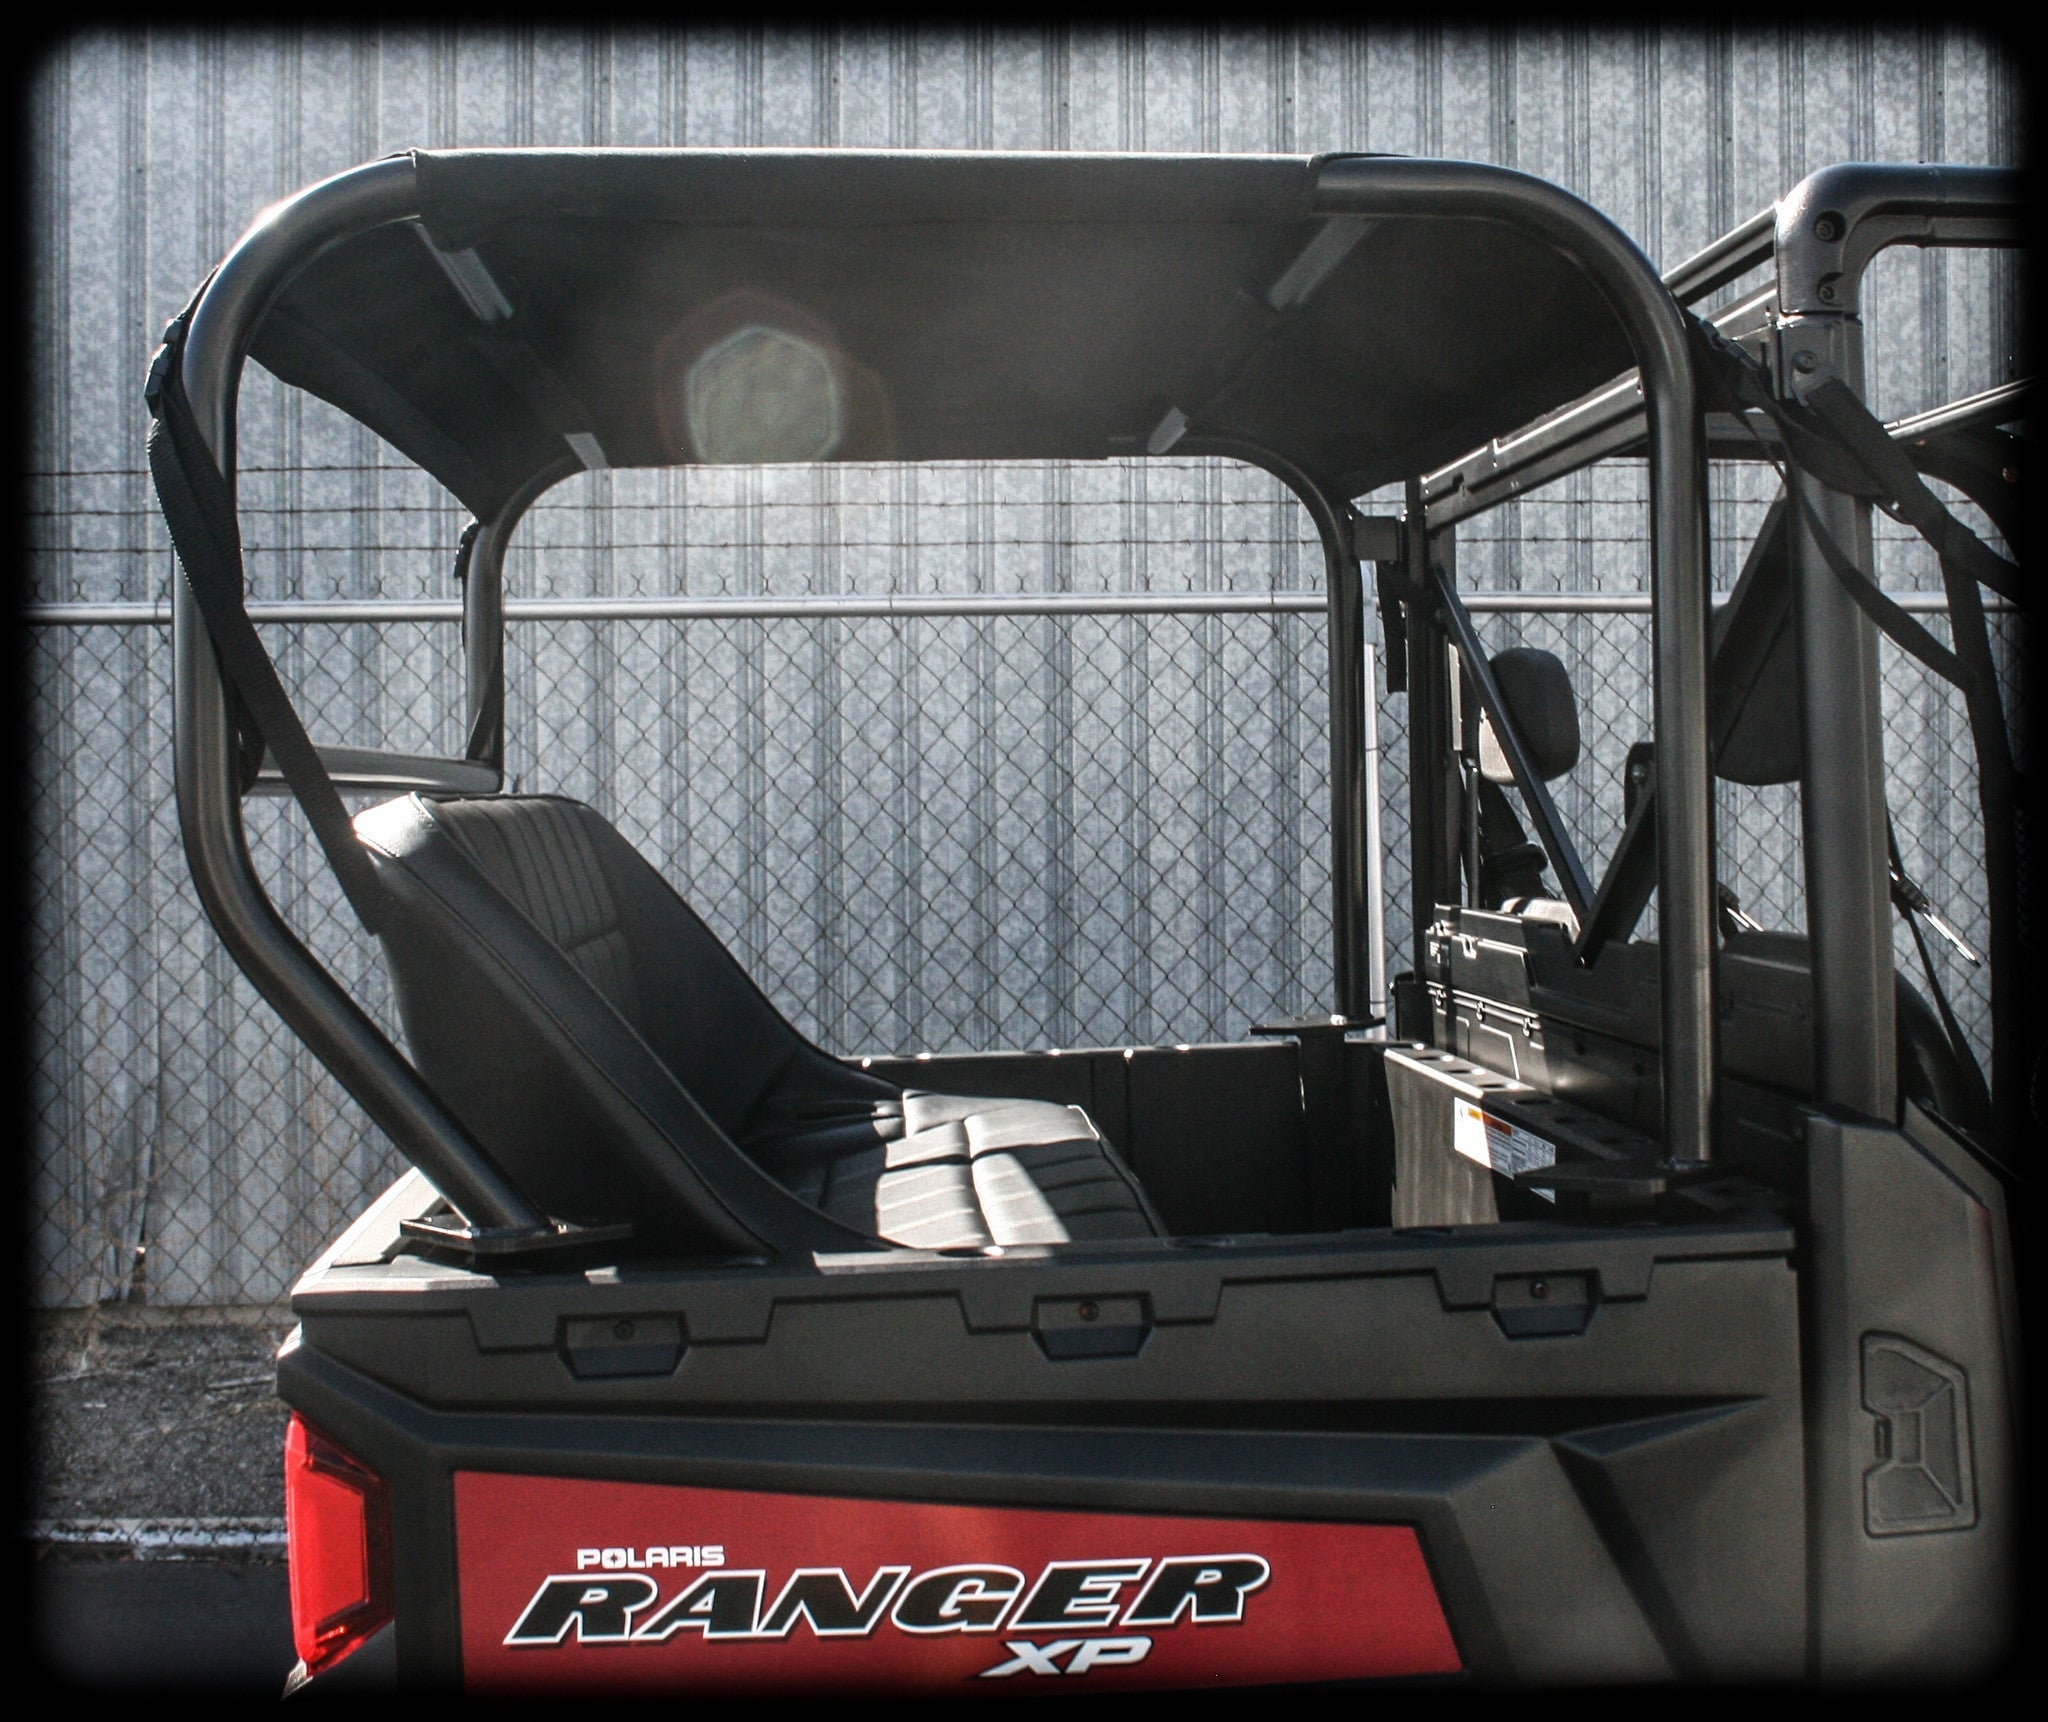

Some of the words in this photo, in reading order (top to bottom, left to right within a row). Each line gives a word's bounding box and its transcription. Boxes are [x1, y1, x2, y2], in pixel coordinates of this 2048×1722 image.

[577, 1546, 725, 1570] POLARIS
[503, 1553, 1271, 1645] RANGER
[979, 1636, 1153, 1677] XP
